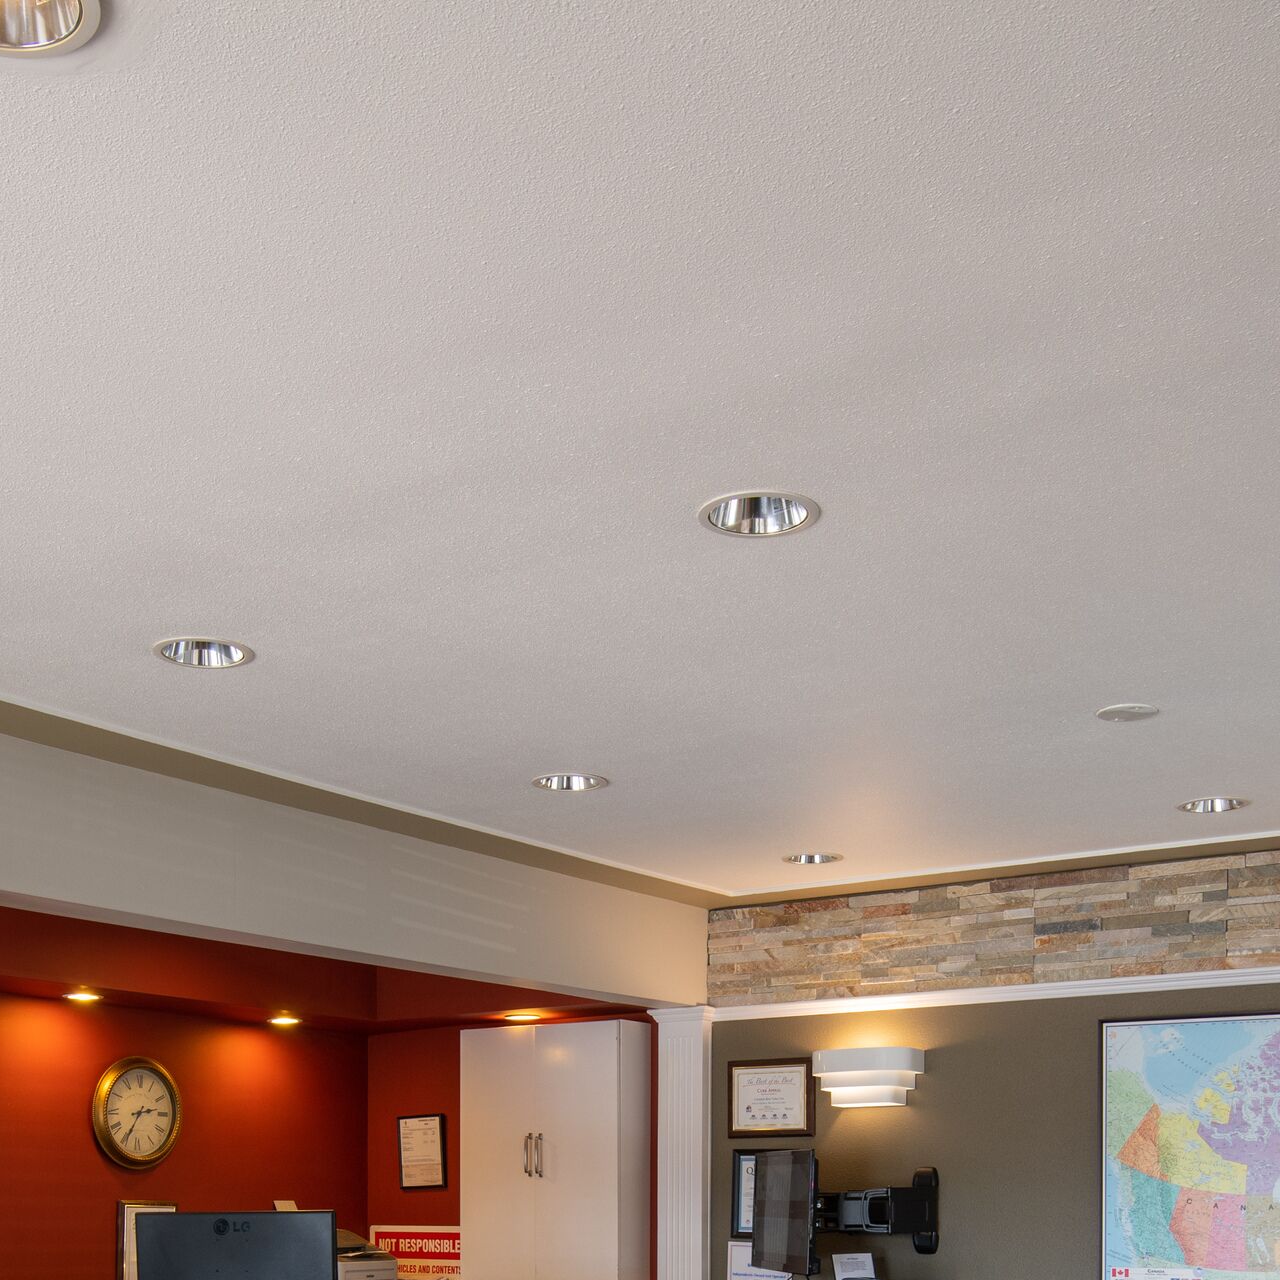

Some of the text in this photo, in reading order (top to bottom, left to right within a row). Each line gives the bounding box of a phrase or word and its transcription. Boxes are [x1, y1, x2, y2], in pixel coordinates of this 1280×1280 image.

[232, 1222, 251, 1232] LG
[379, 1238, 460, 1253] NOT RESPONSIBLE
[397, 1265, 416, 1273] HICLES
